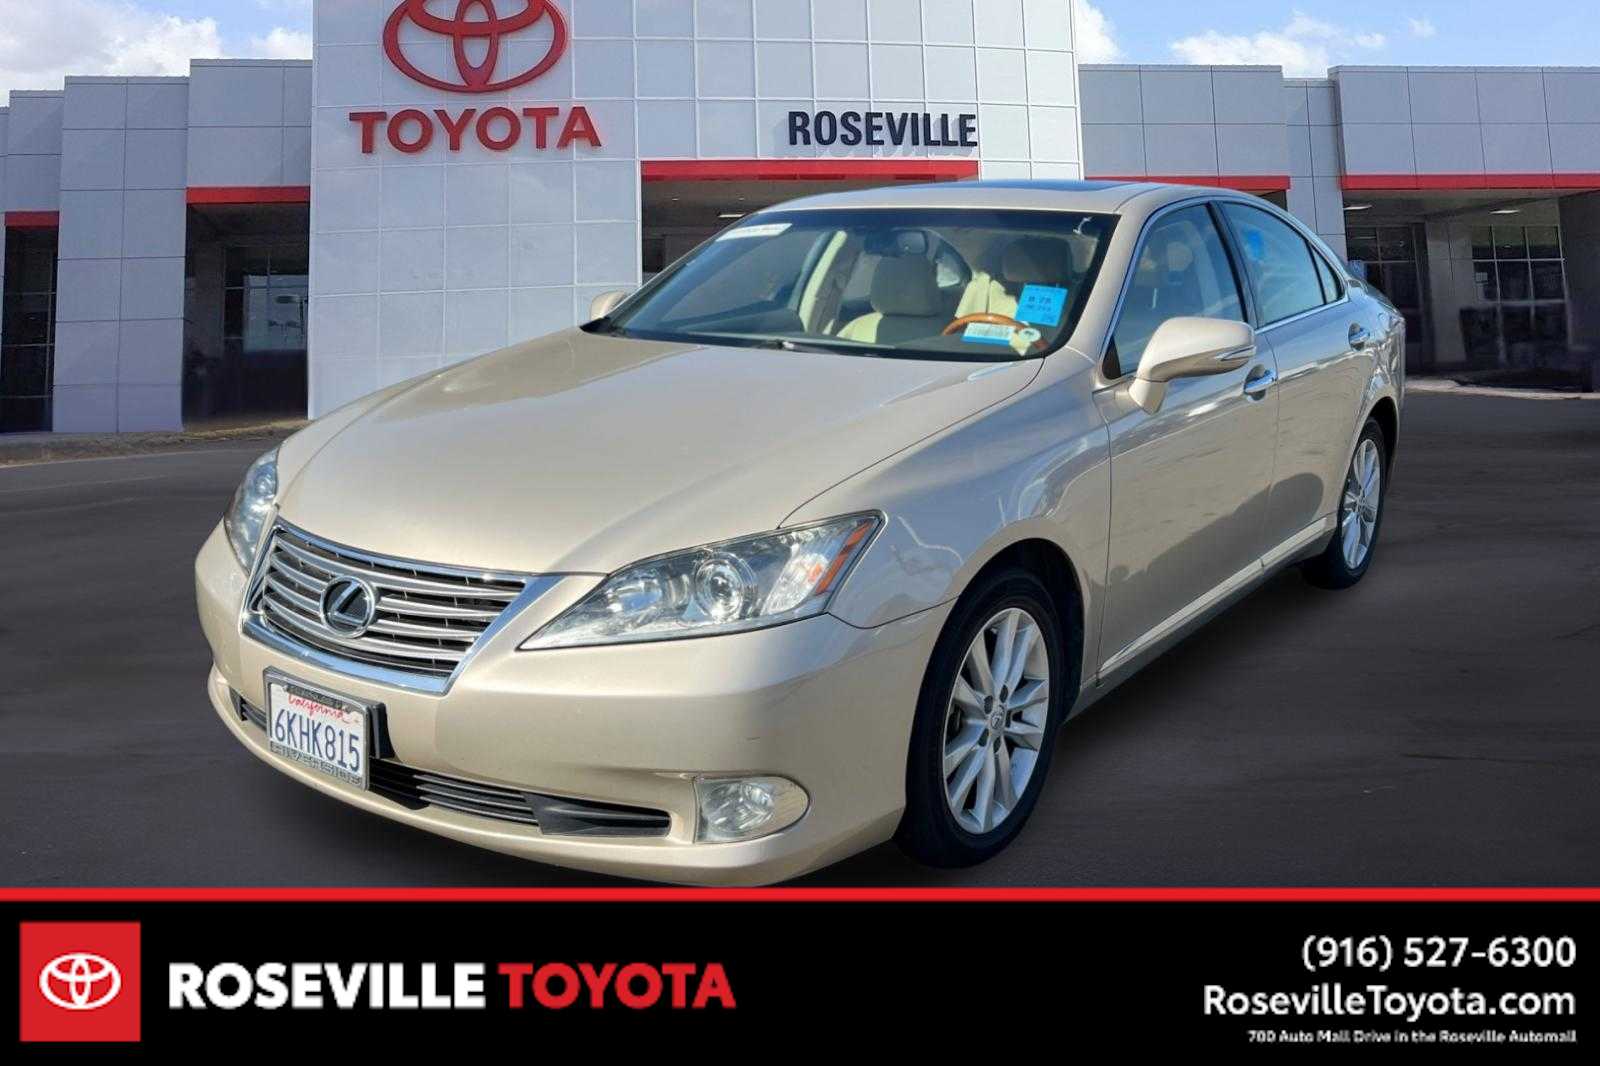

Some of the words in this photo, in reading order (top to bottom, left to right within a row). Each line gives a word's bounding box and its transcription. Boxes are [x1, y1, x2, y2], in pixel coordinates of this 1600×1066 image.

[349, 106, 602, 154] TOYOTA
[788, 110, 978, 147] ROSEVILLE
[275, 708, 360, 773] 6KHK815
